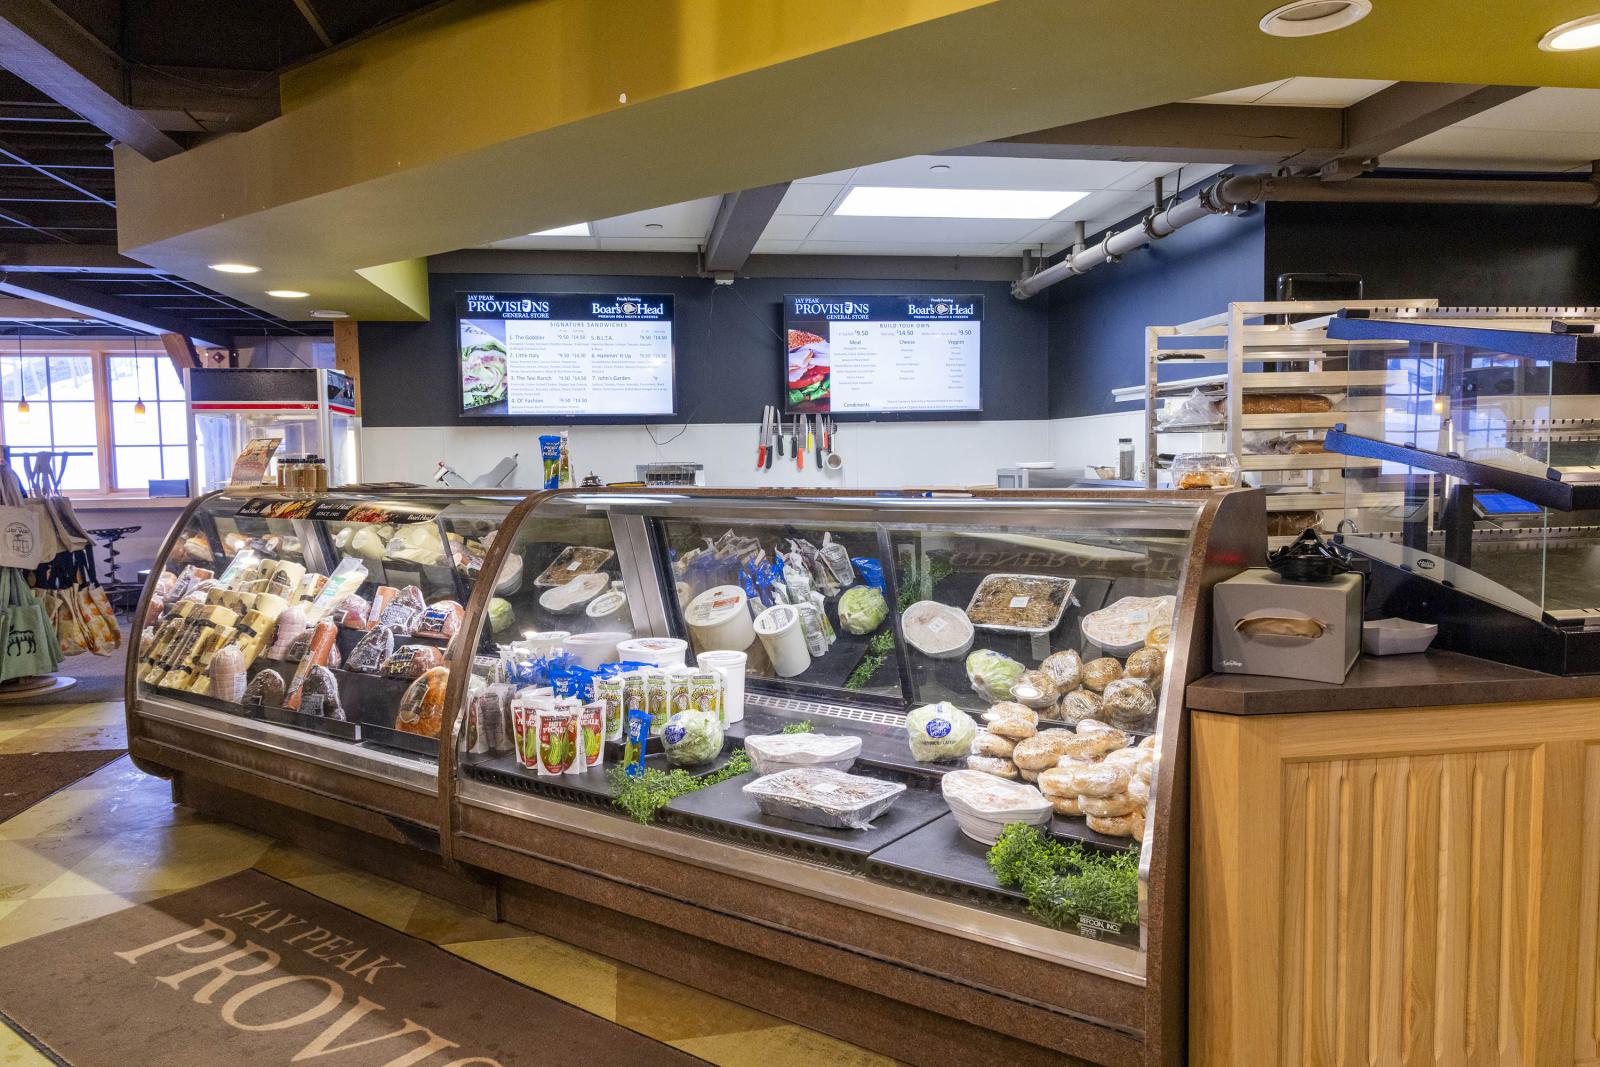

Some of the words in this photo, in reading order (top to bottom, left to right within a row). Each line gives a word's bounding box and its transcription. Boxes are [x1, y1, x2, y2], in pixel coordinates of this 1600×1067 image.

[592, 302, 620, 314] Boar's
[637, 303, 664, 314] Head
[909, 304, 934, 315] Boar's
[950, 304, 973, 315] Head
[218, 901, 308, 934] JAY
[284, 926, 406, 985] PEAK
